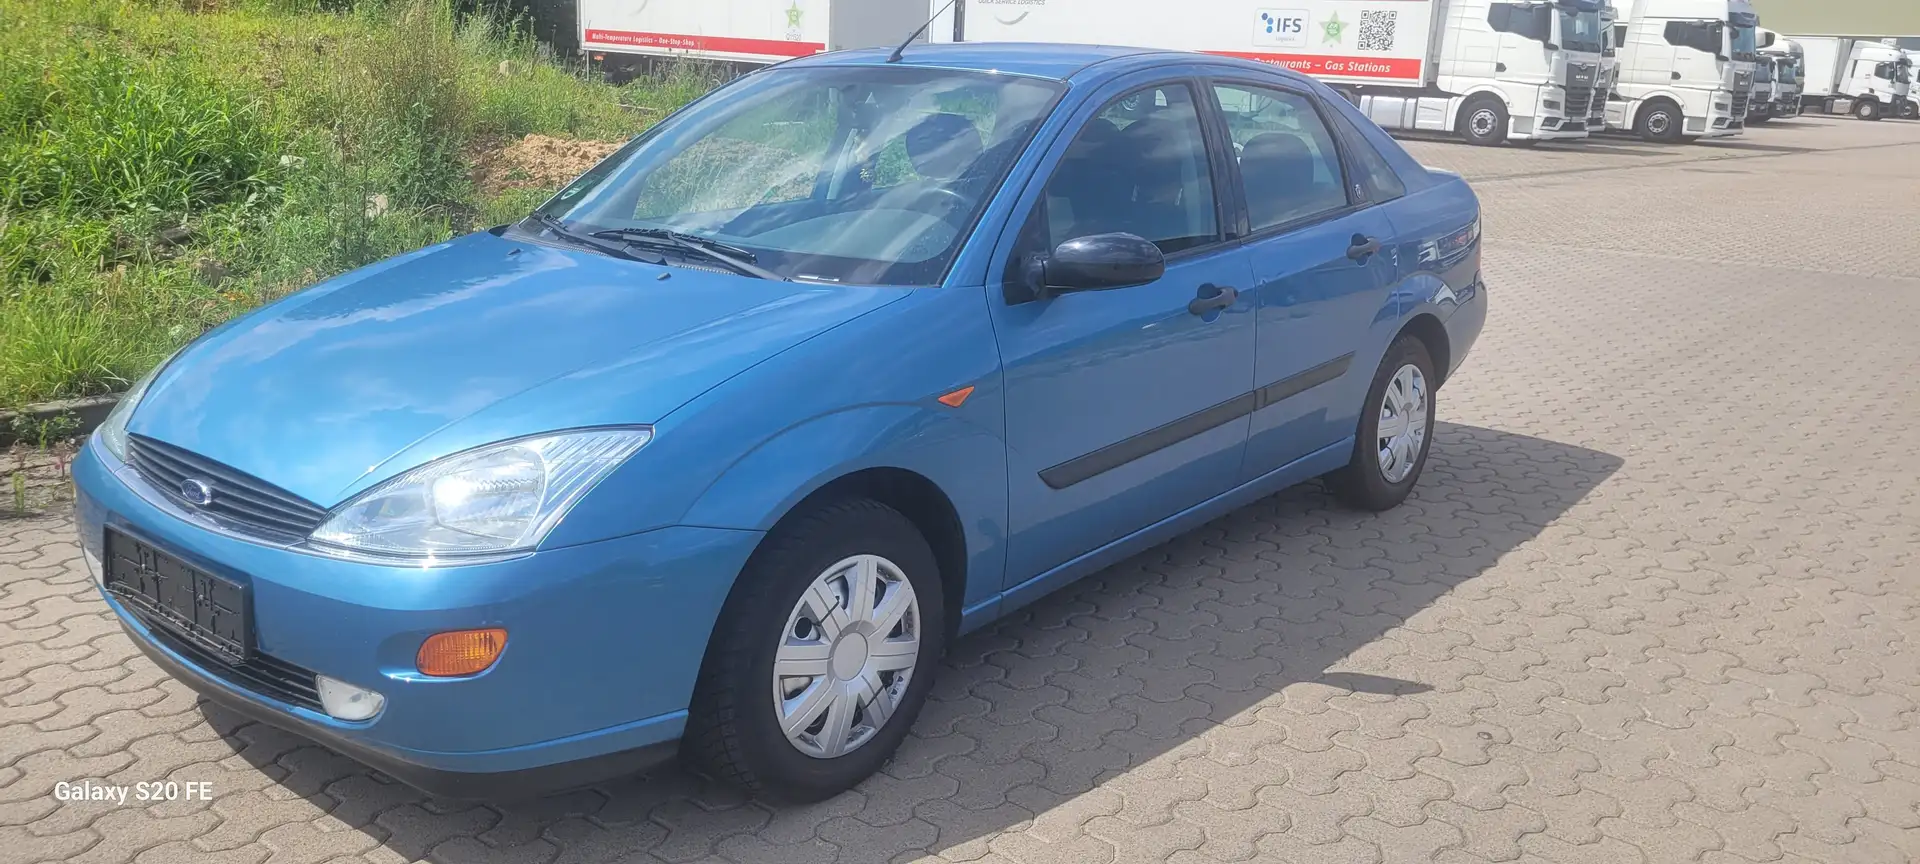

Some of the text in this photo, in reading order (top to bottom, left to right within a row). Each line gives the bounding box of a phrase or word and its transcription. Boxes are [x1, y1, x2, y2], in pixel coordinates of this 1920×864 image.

[1276, 18, 1302, 33] IFS
[1325, 60, 1344, 71] Gas
[1348, 61, 1391, 73] Stations
